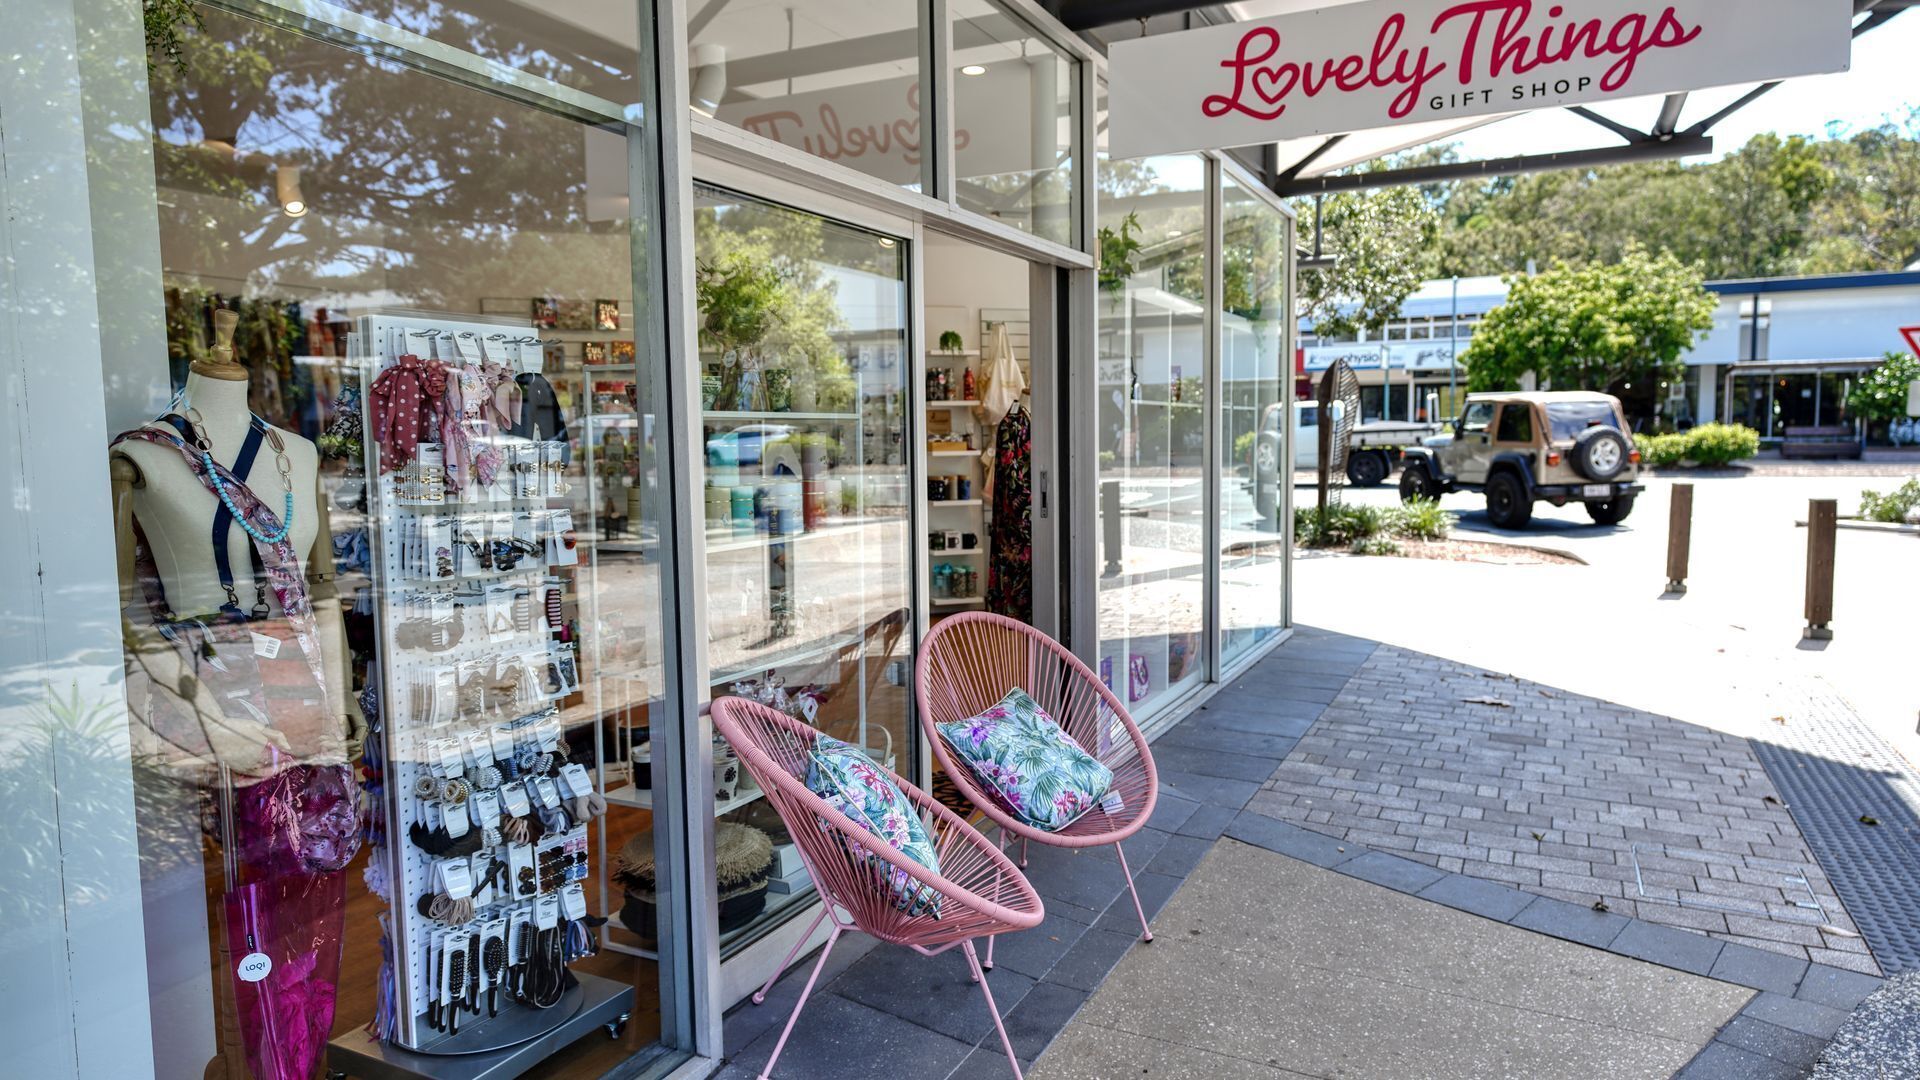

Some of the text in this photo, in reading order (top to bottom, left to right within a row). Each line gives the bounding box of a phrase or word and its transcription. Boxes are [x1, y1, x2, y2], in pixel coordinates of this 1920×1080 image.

[1202, 0, 1702, 120] Lovely Things
[1429, 76, 1592, 110] GIFT SHOP
[245, 961, 266, 972] LOQI
